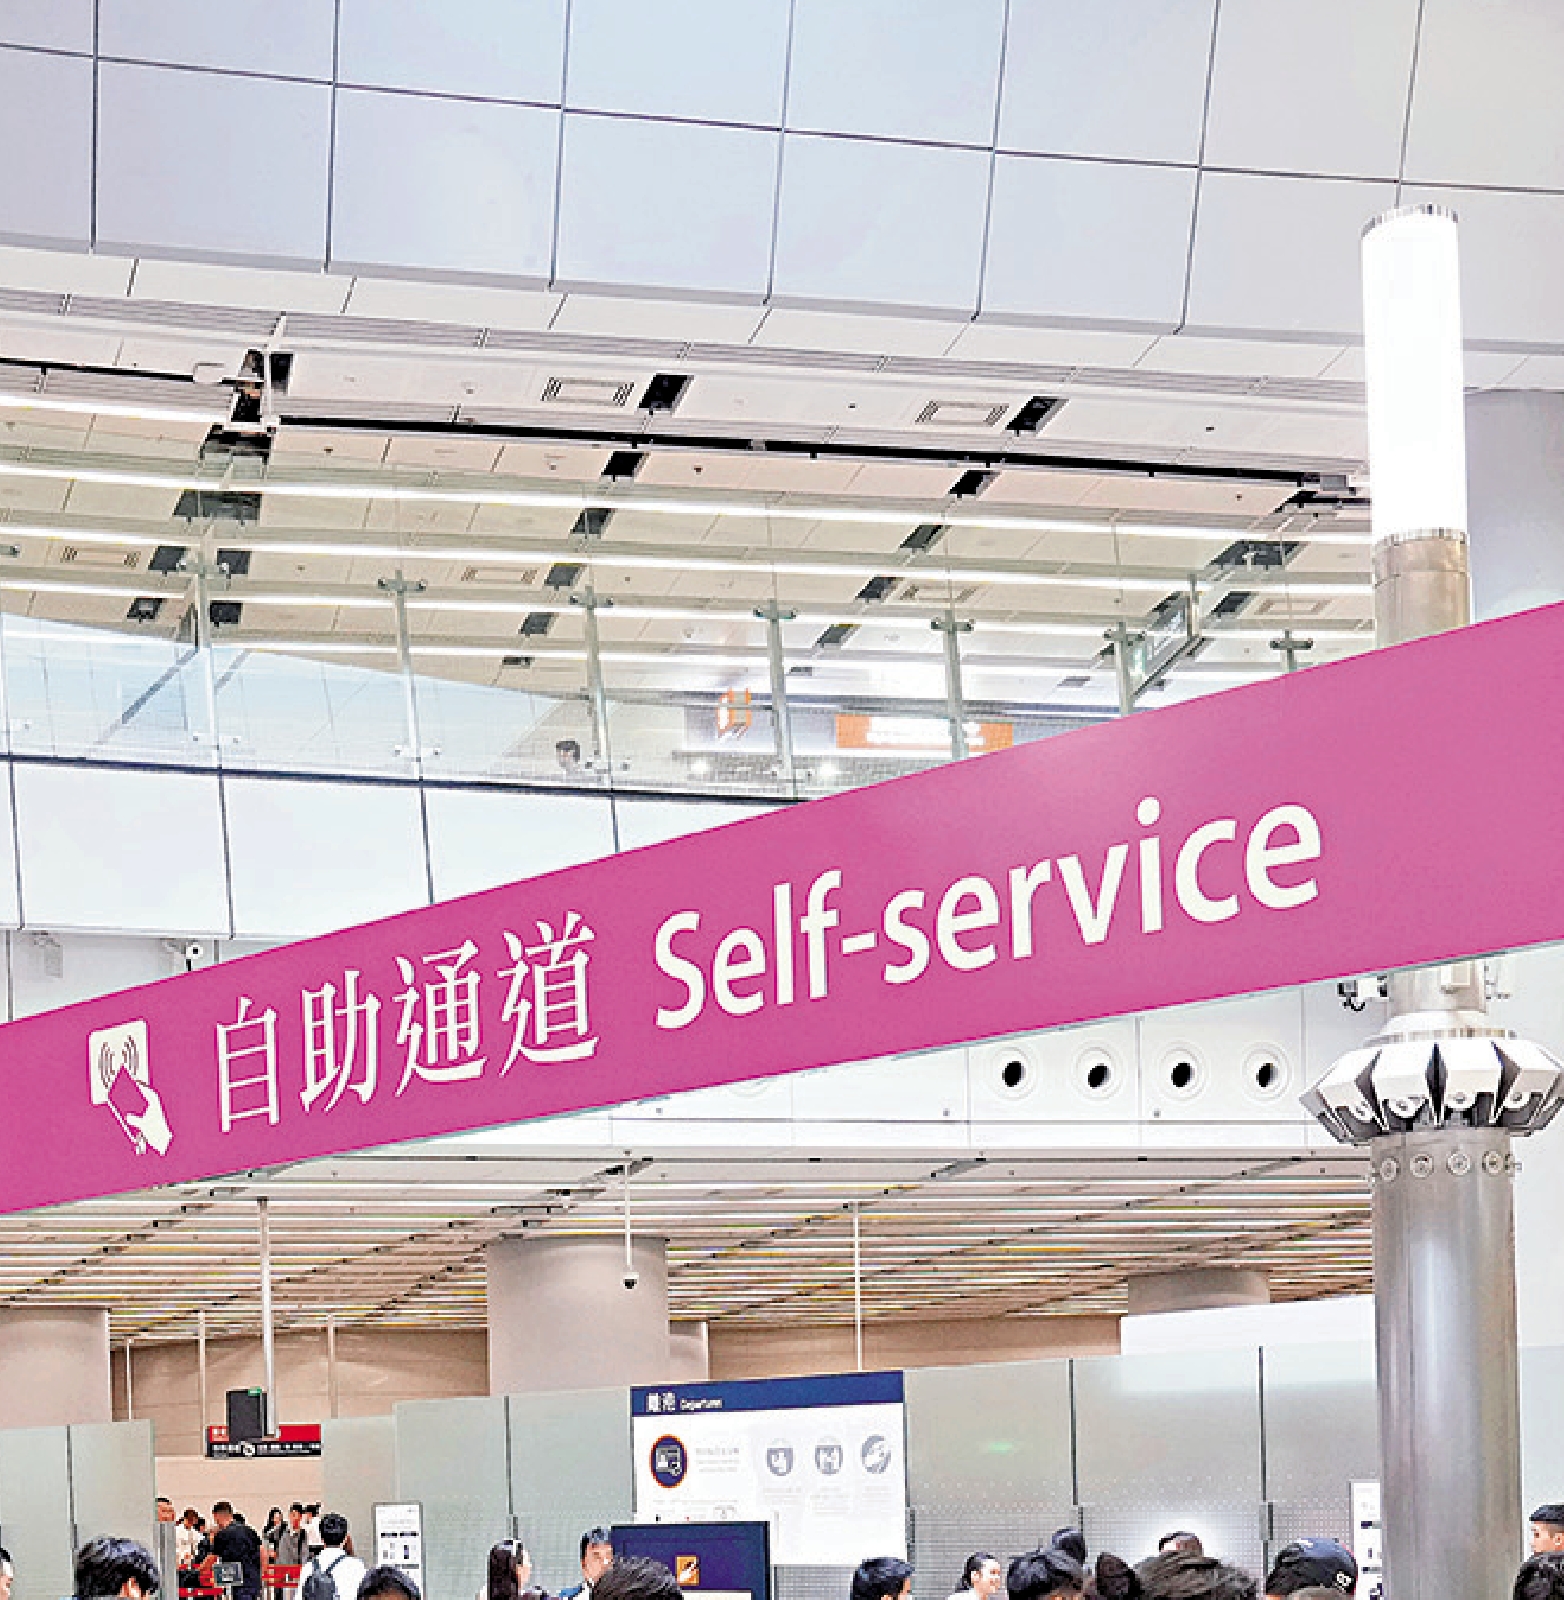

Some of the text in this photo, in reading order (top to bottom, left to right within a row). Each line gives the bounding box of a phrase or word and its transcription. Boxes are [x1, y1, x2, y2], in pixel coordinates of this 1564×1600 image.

[216, 911, 599, 1133] 自助通道
[655, 796, 1321, 1029] Self-service
